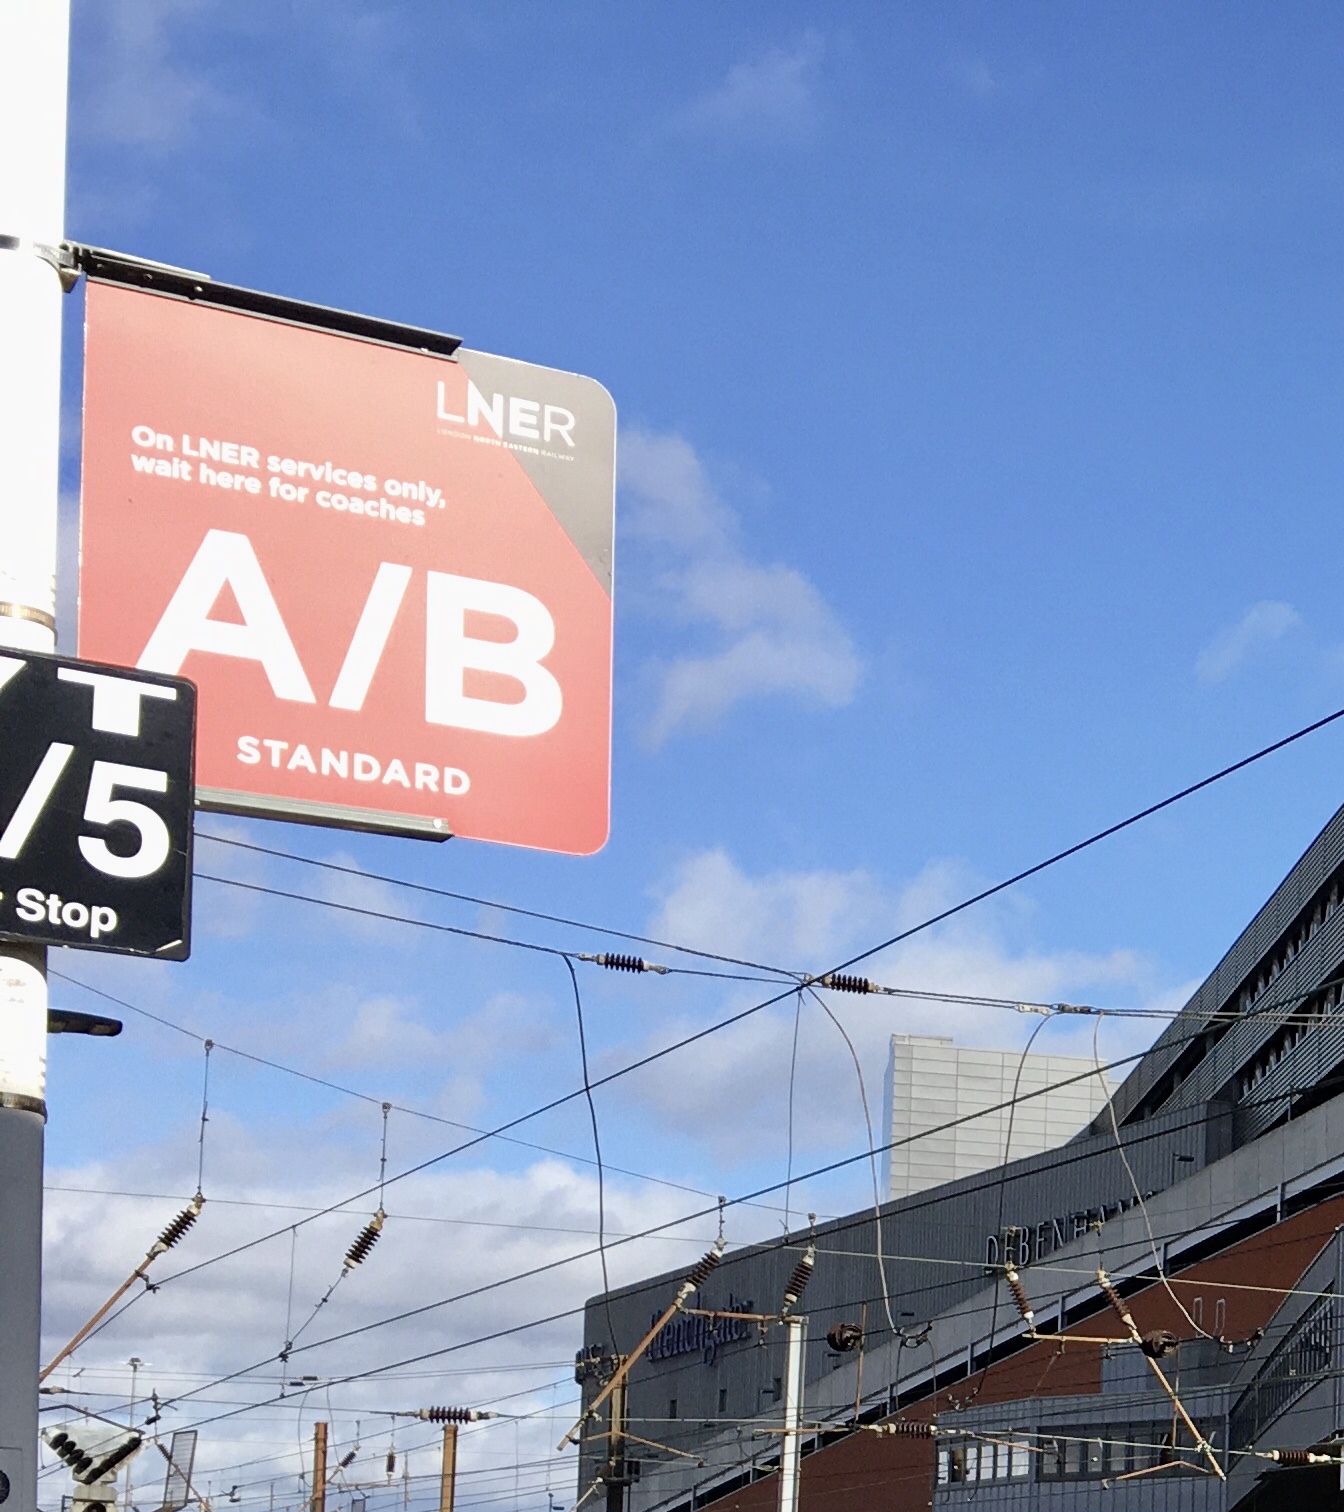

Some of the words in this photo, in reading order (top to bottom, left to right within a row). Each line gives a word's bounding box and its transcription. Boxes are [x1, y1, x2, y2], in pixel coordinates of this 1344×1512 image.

[437, 379, 575, 447] LNER
[437, 427, 471, 440] LONDON
[473, 435, 501, 446] NORTH
[503, 442, 539, 455] EASTERN
[541, 450, 575, 461] RAILWAY
[131, 425, 174, 452] On
[182, 434, 259, 469] LNER
[267, 455, 377, 491] services
[384, 478, 446, 509] only,
[131, 453, 192, 481] wait
[199, 463, 262, 494] here
[268, 477, 309, 502] for
[315, 490, 425, 526] coaches
[135, 528, 563, 737] A/B
[237, 735, 470, 795] STANDARD
[15, 888, 118, 938] Stop
